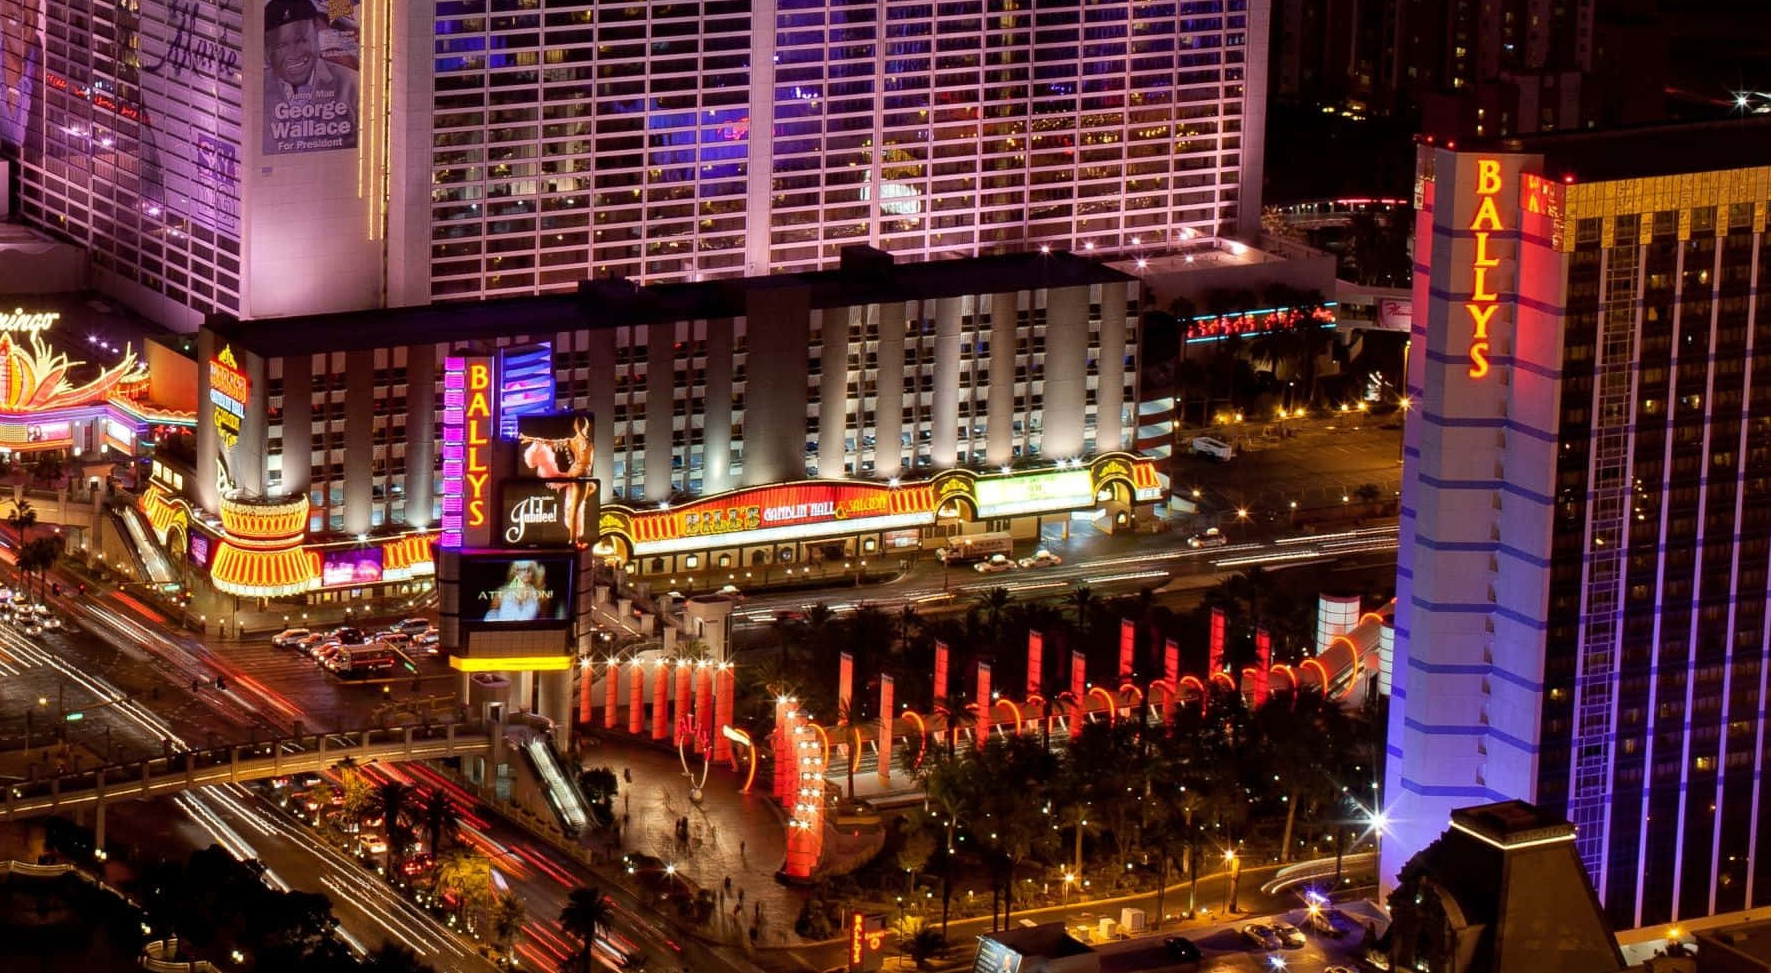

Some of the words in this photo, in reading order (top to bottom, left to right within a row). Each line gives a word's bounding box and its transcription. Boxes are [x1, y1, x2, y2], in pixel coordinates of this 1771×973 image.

[316, 89, 335, 99] Man
[274, 100, 348, 120] George
[271, 120, 351, 140] Wallace
[278, 140, 294, 150] For
[297, 137, 343, 149] President
[1465, 159, 1504, 378] BALLYS
[466, 364, 491, 526] BALLYS
[505, 496, 558, 543] Jubilee!
[685, 507, 760, 534] BILL'S
[810, 501, 834, 517] HALL
[835, 502, 847, 519] &
[848, 497, 887, 512] SALOON
[477, 590, 554, 600] ATTNTION!
